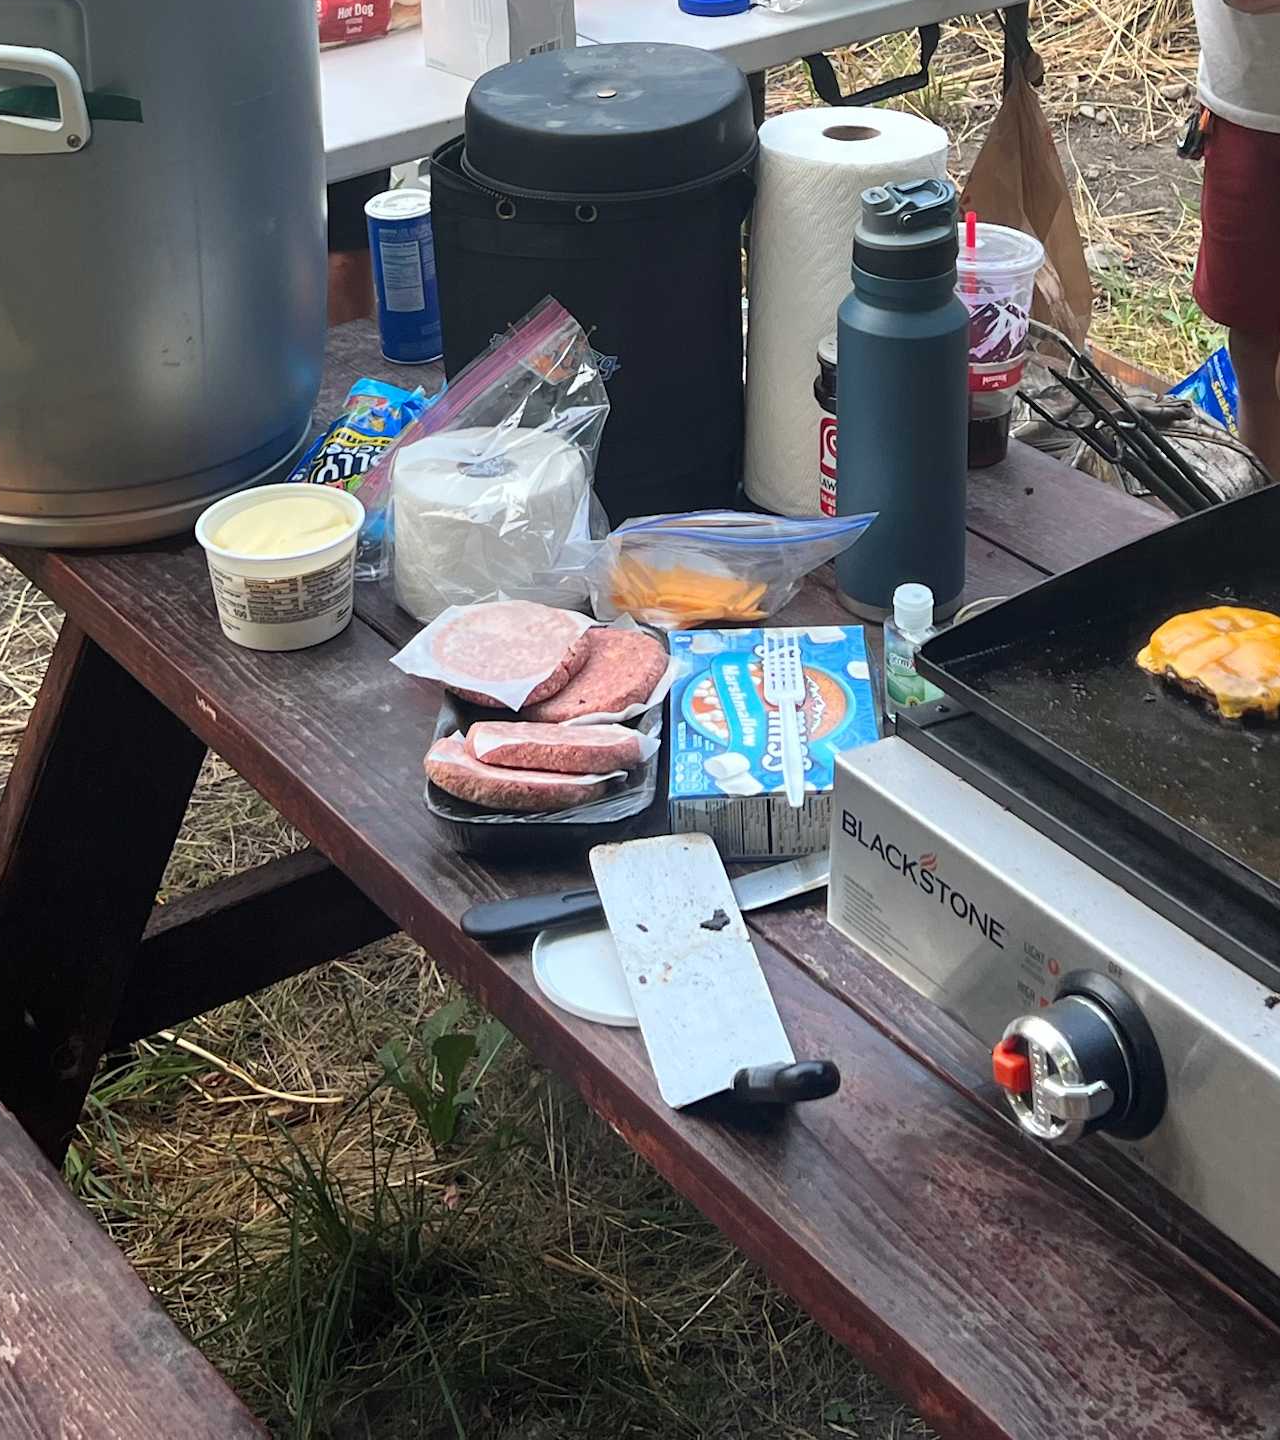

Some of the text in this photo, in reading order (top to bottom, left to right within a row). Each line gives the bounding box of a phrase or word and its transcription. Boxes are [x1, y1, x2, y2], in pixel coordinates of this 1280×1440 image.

[337, 3, 374, 20] Hot Dog
[317, 453, 382, 483] LLY
[722, 664, 758, 747] Marshmallow
[841, 808, 1006, 950] BLACKSTONE
